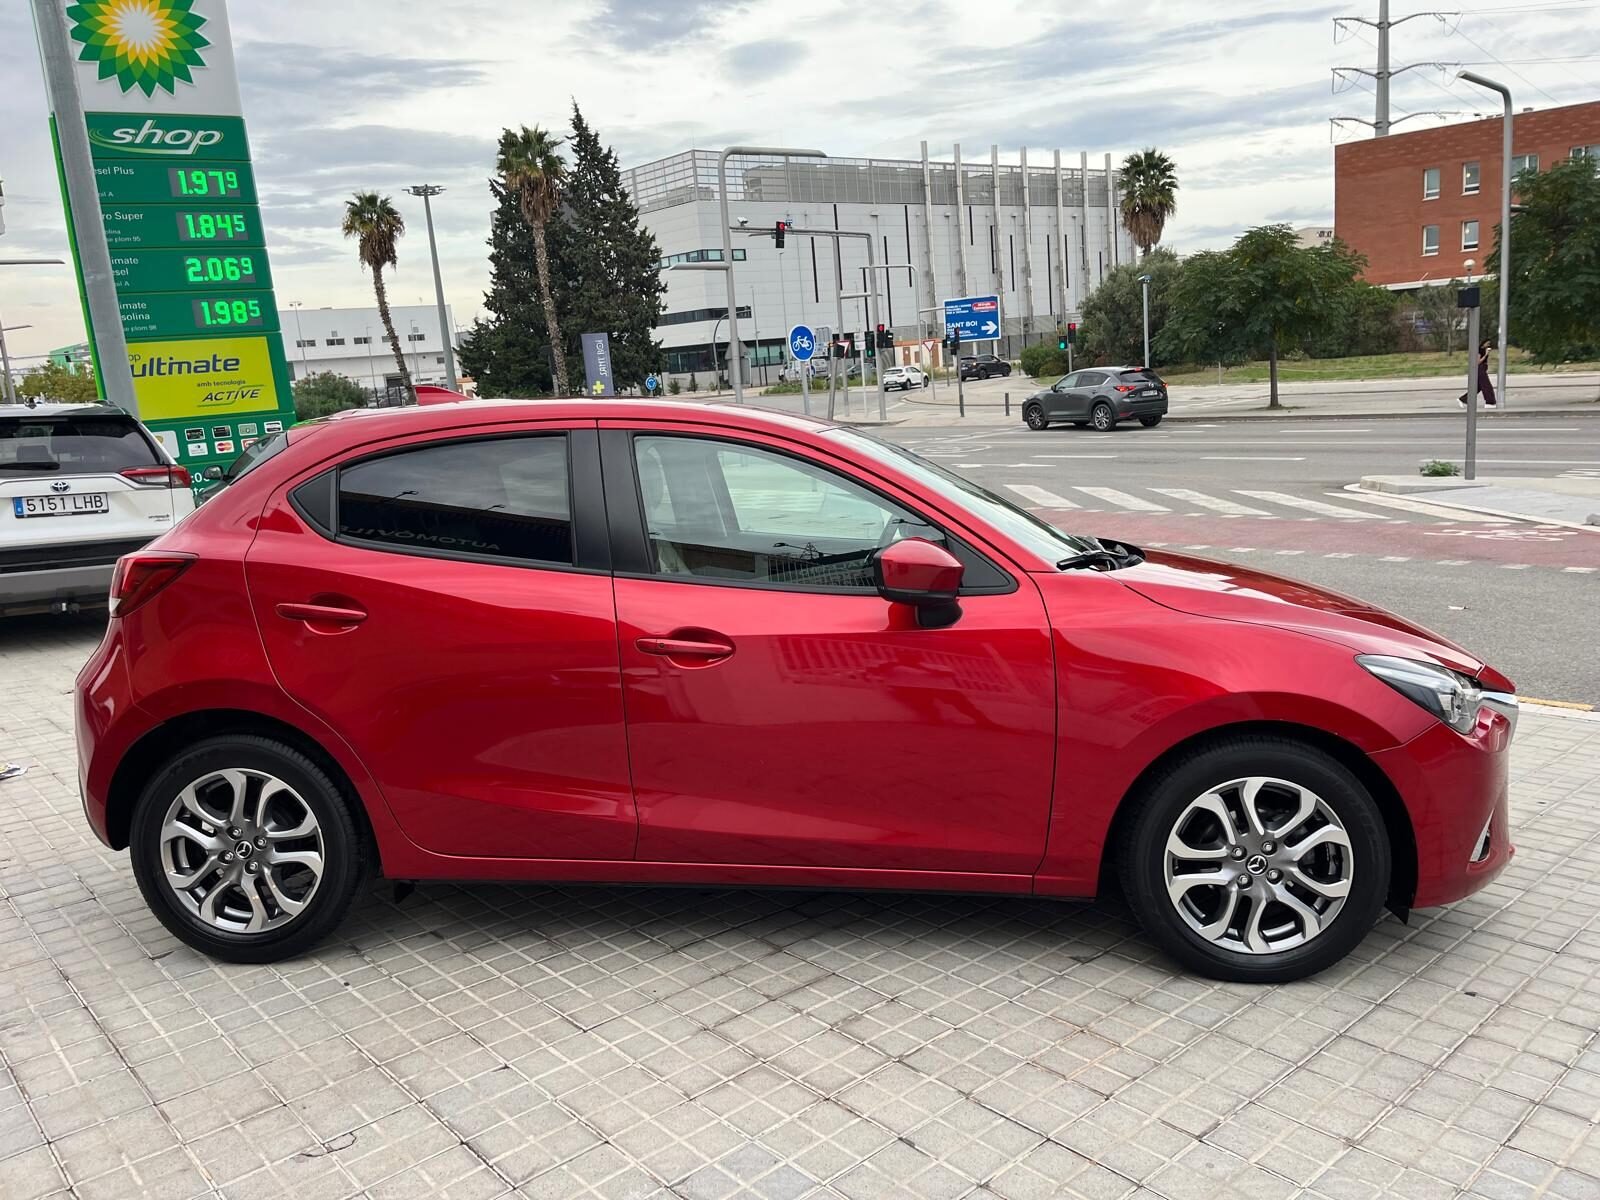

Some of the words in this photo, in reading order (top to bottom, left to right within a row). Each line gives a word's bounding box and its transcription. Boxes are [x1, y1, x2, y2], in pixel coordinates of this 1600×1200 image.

[110, 119, 222, 154] shop
[113, 166, 135, 175] Plus
[177, 170, 238, 195] 1.979
[114, 211, 144, 222] Super
[185, 214, 245, 239] 1.845
[111, 256, 139, 265] imate
[186, 257, 253, 282] 2.069
[119, 302, 147, 310] imate
[201, 300, 261, 325] 1.985
[121, 312, 150, 321] solina
[130, 353, 240, 378] ultimate
[202, 389, 261, 402] ACTIVE
[26, 498, 66, 512] 5151
[73, 495, 104, 509] LHB
